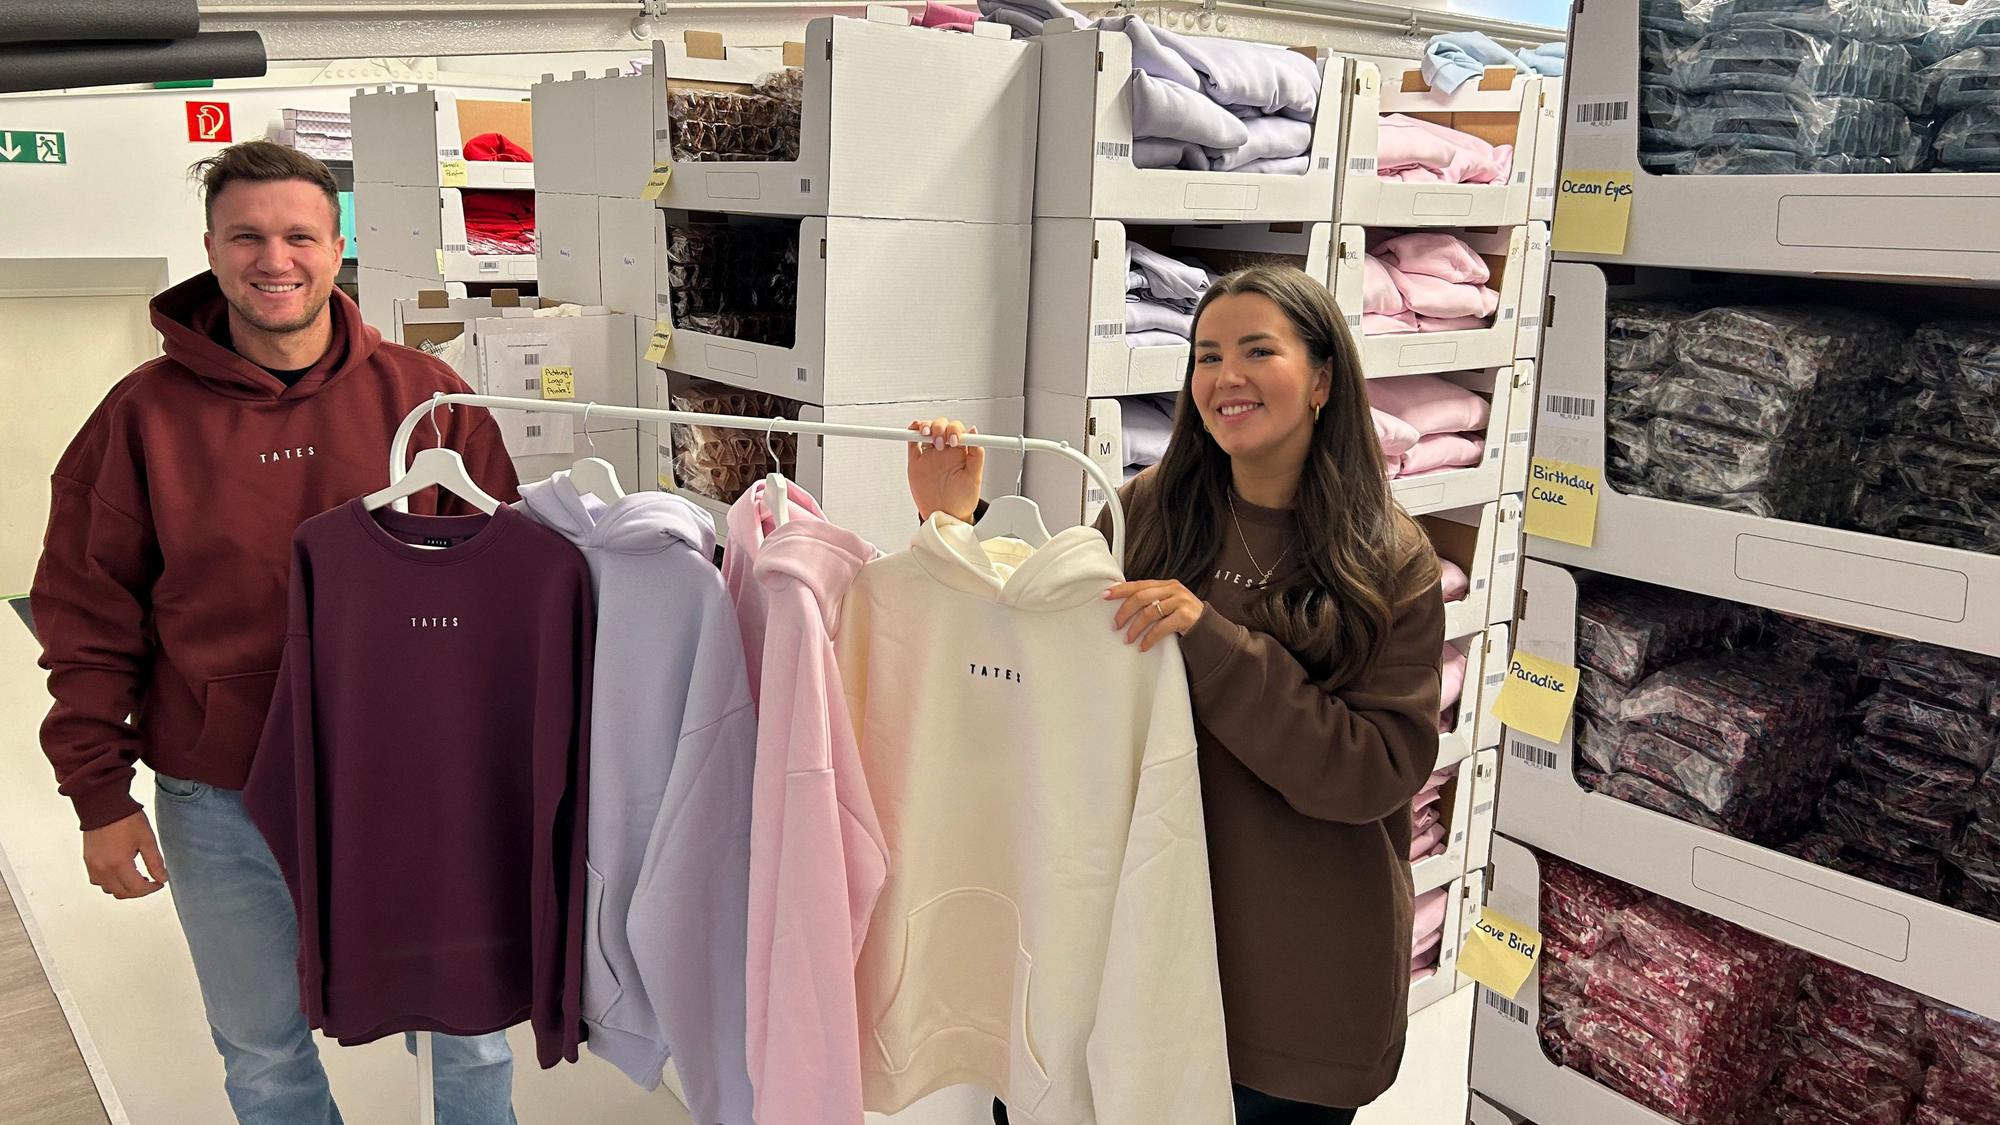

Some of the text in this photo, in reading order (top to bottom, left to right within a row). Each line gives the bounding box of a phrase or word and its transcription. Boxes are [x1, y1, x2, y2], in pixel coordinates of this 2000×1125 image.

[1562, 180, 1632, 202] Ocean Eyes
[260, 446, 314, 463] TATES
[1100, 442, 1111, 455] M
[1533, 465, 1594, 495] Birthday
[1532, 487, 1567, 505] Cake
[1509, 510, 1516, 520] M
[1214, 569, 1253, 588] ATES
[411, 617, 458, 627] TATES
[1510, 661, 1566, 692] Paradise
[1484, 767, 1491, 778] M
[1469, 904, 1476, 914] M
[1476, 918, 1535, 959] Love Bird
